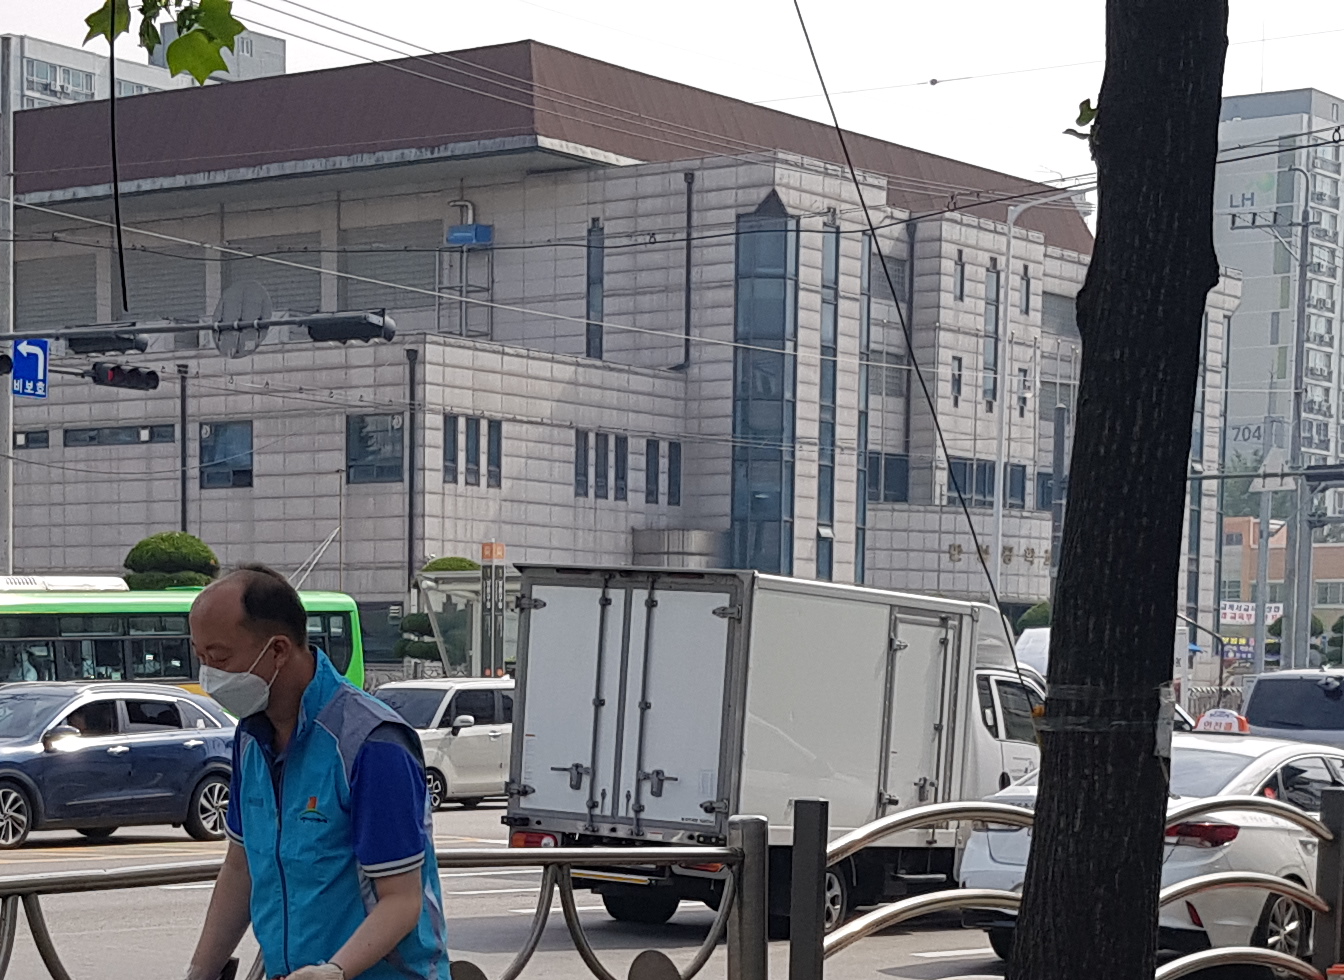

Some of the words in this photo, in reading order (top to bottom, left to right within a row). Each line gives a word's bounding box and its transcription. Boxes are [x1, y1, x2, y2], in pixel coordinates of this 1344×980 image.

[1229, 192, 1254, 208] LH
[13, 378, 46, 395] 비보호
[1231, 425, 1262, 442] 704
